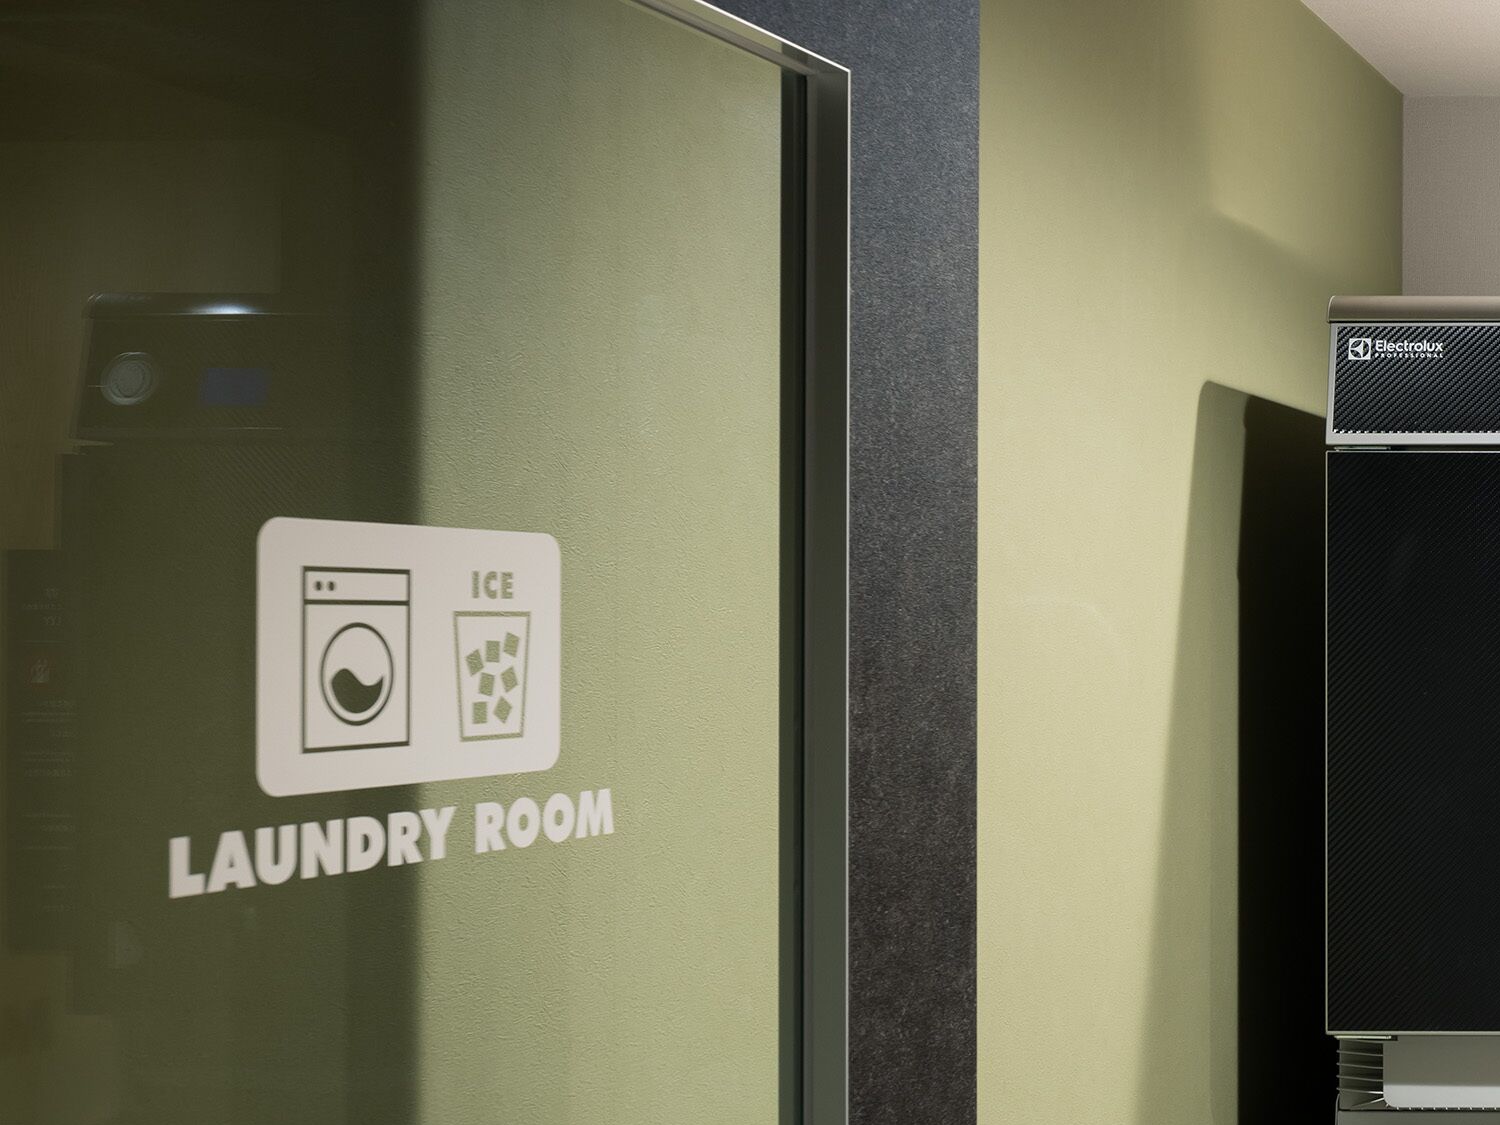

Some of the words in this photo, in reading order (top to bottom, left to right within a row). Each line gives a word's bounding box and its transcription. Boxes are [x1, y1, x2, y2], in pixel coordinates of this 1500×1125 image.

[1375, 340, 1443, 352] Electrolux
[471, 570, 514, 599] ICE
[168, 806, 455, 899] LAUNDRY
[474, 788, 615, 854] ROOM
